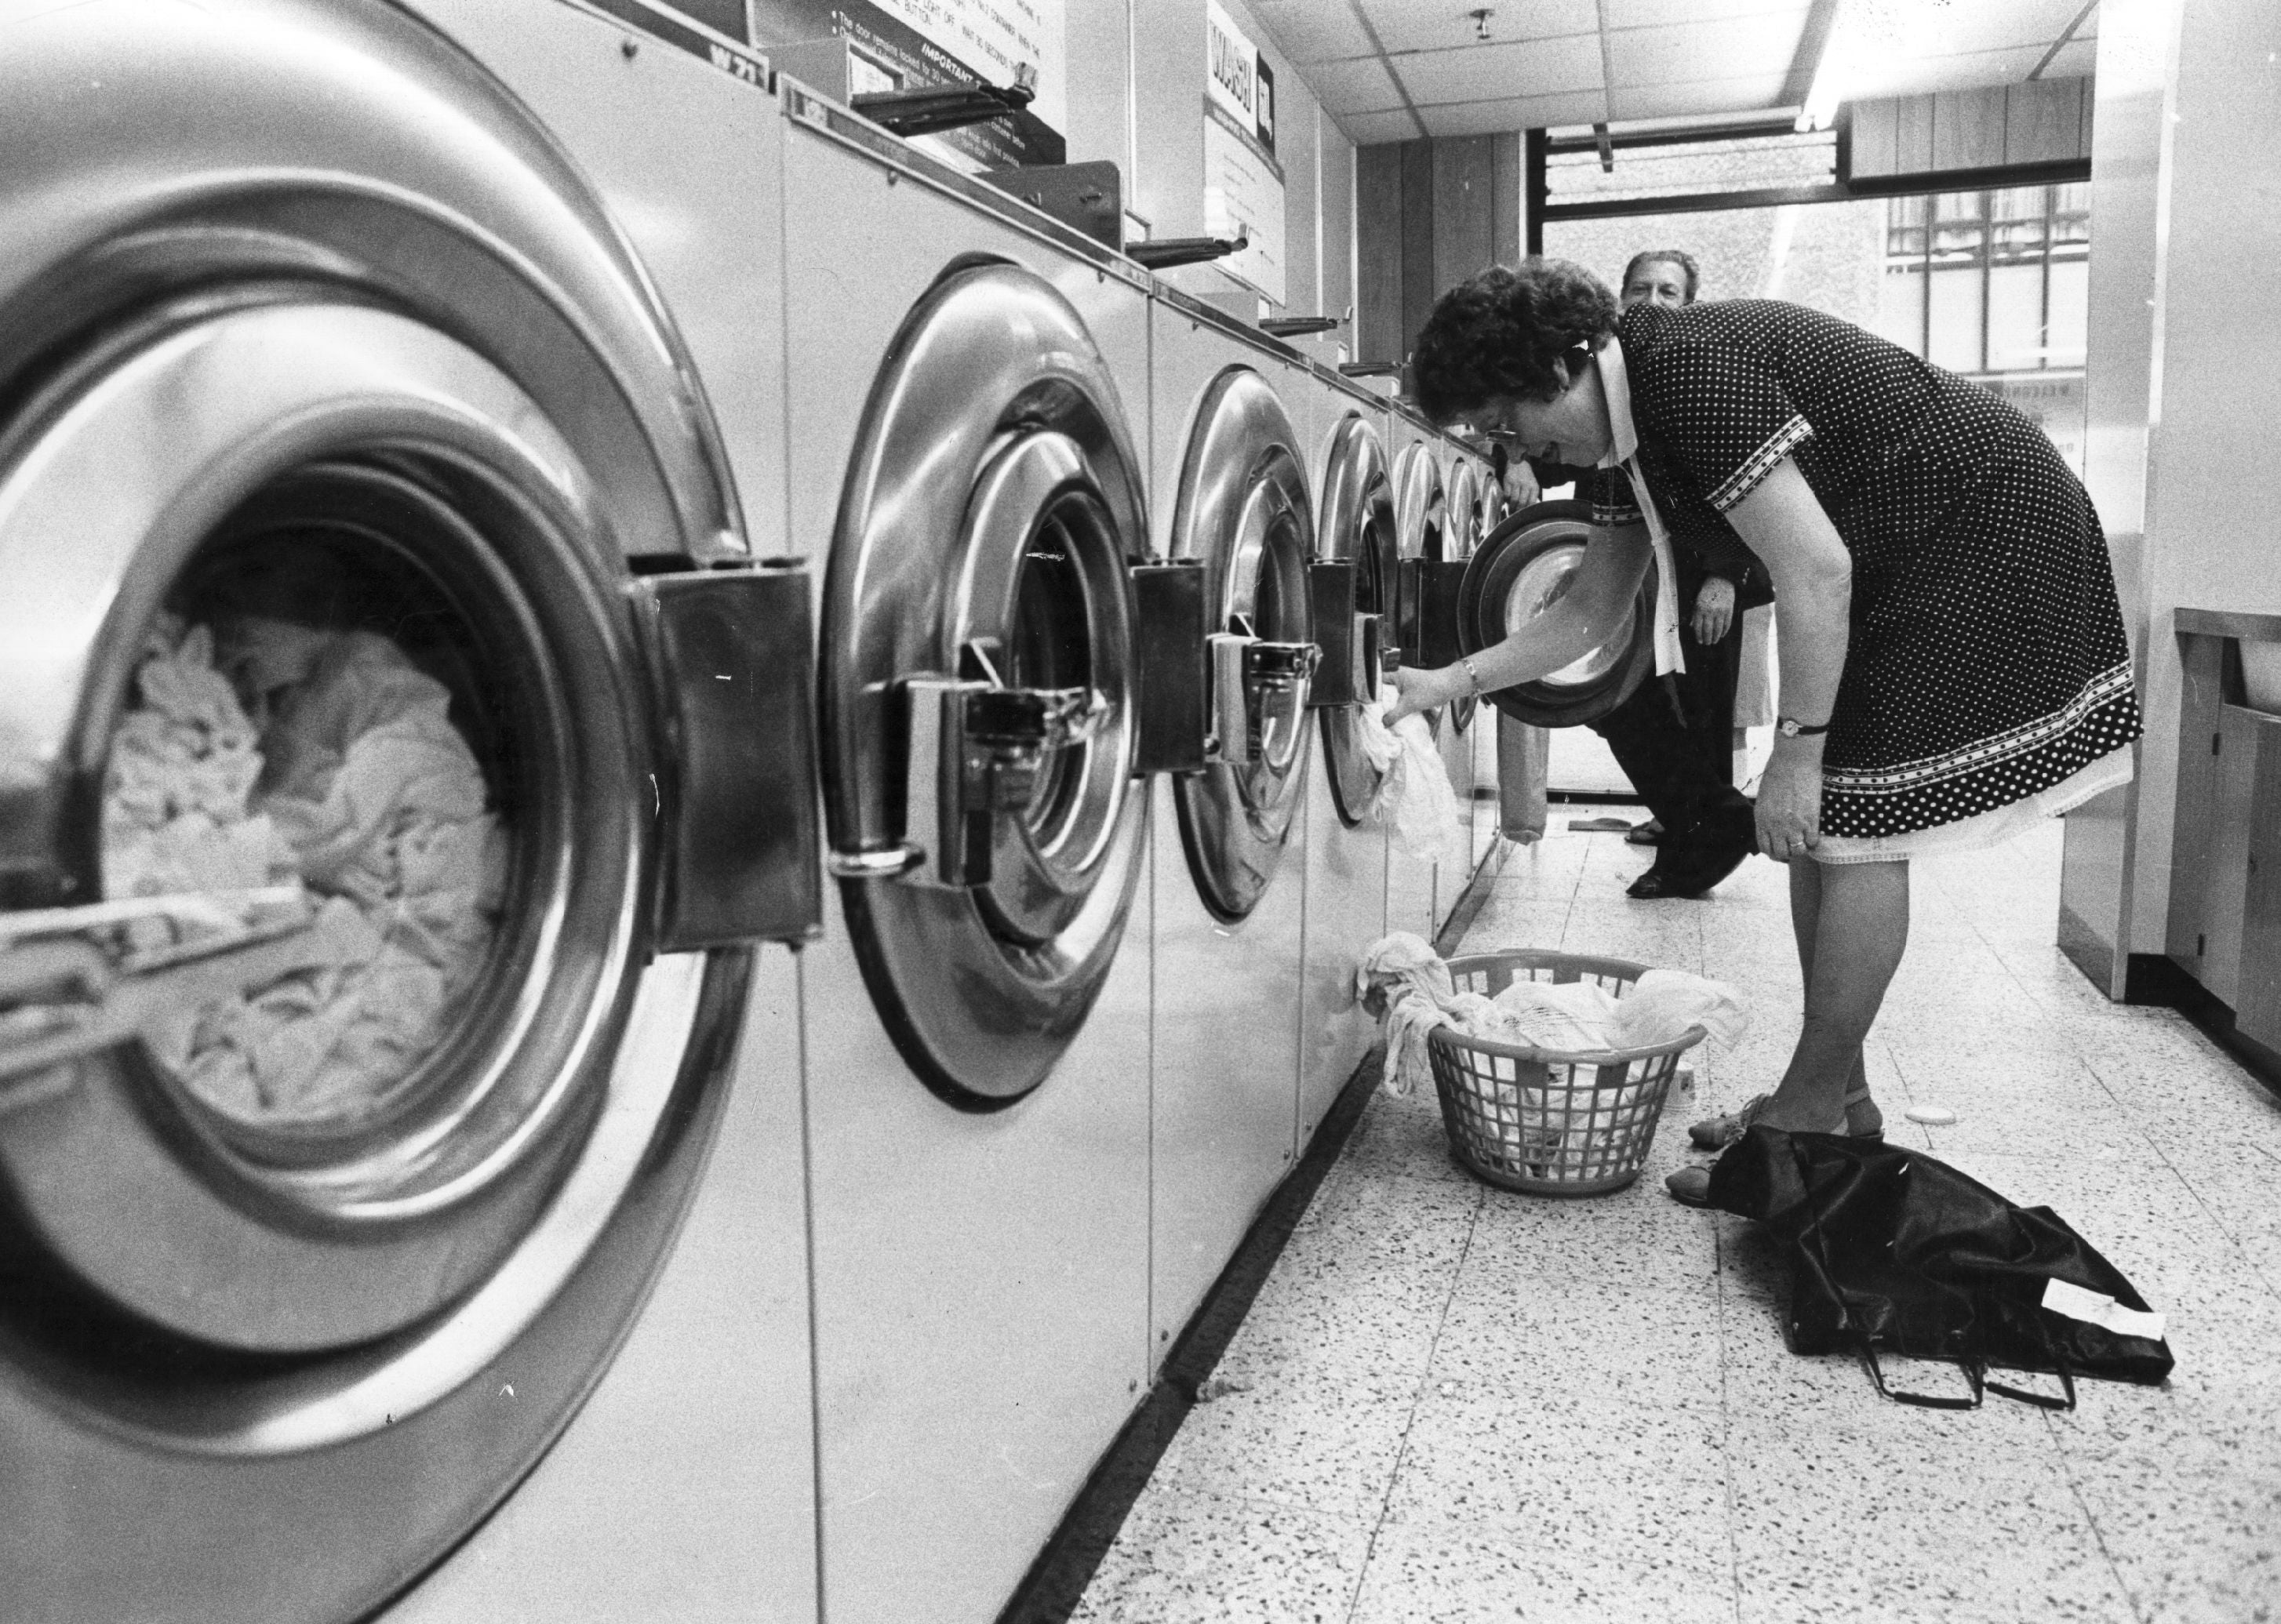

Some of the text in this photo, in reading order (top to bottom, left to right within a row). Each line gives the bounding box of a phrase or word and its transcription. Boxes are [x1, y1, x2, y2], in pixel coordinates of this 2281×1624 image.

[839, 11, 853, 29] The
[856, 23, 871, 39] door
[873, 33, 897, 56] remains
[900, 48, 920, 69] locked
[922, 62, 930, 76] for
[932, 67, 940, 82] 30
[921, 42, 973, 82] IMPORTANT
[1210, 20, 1252, 114] WASH
